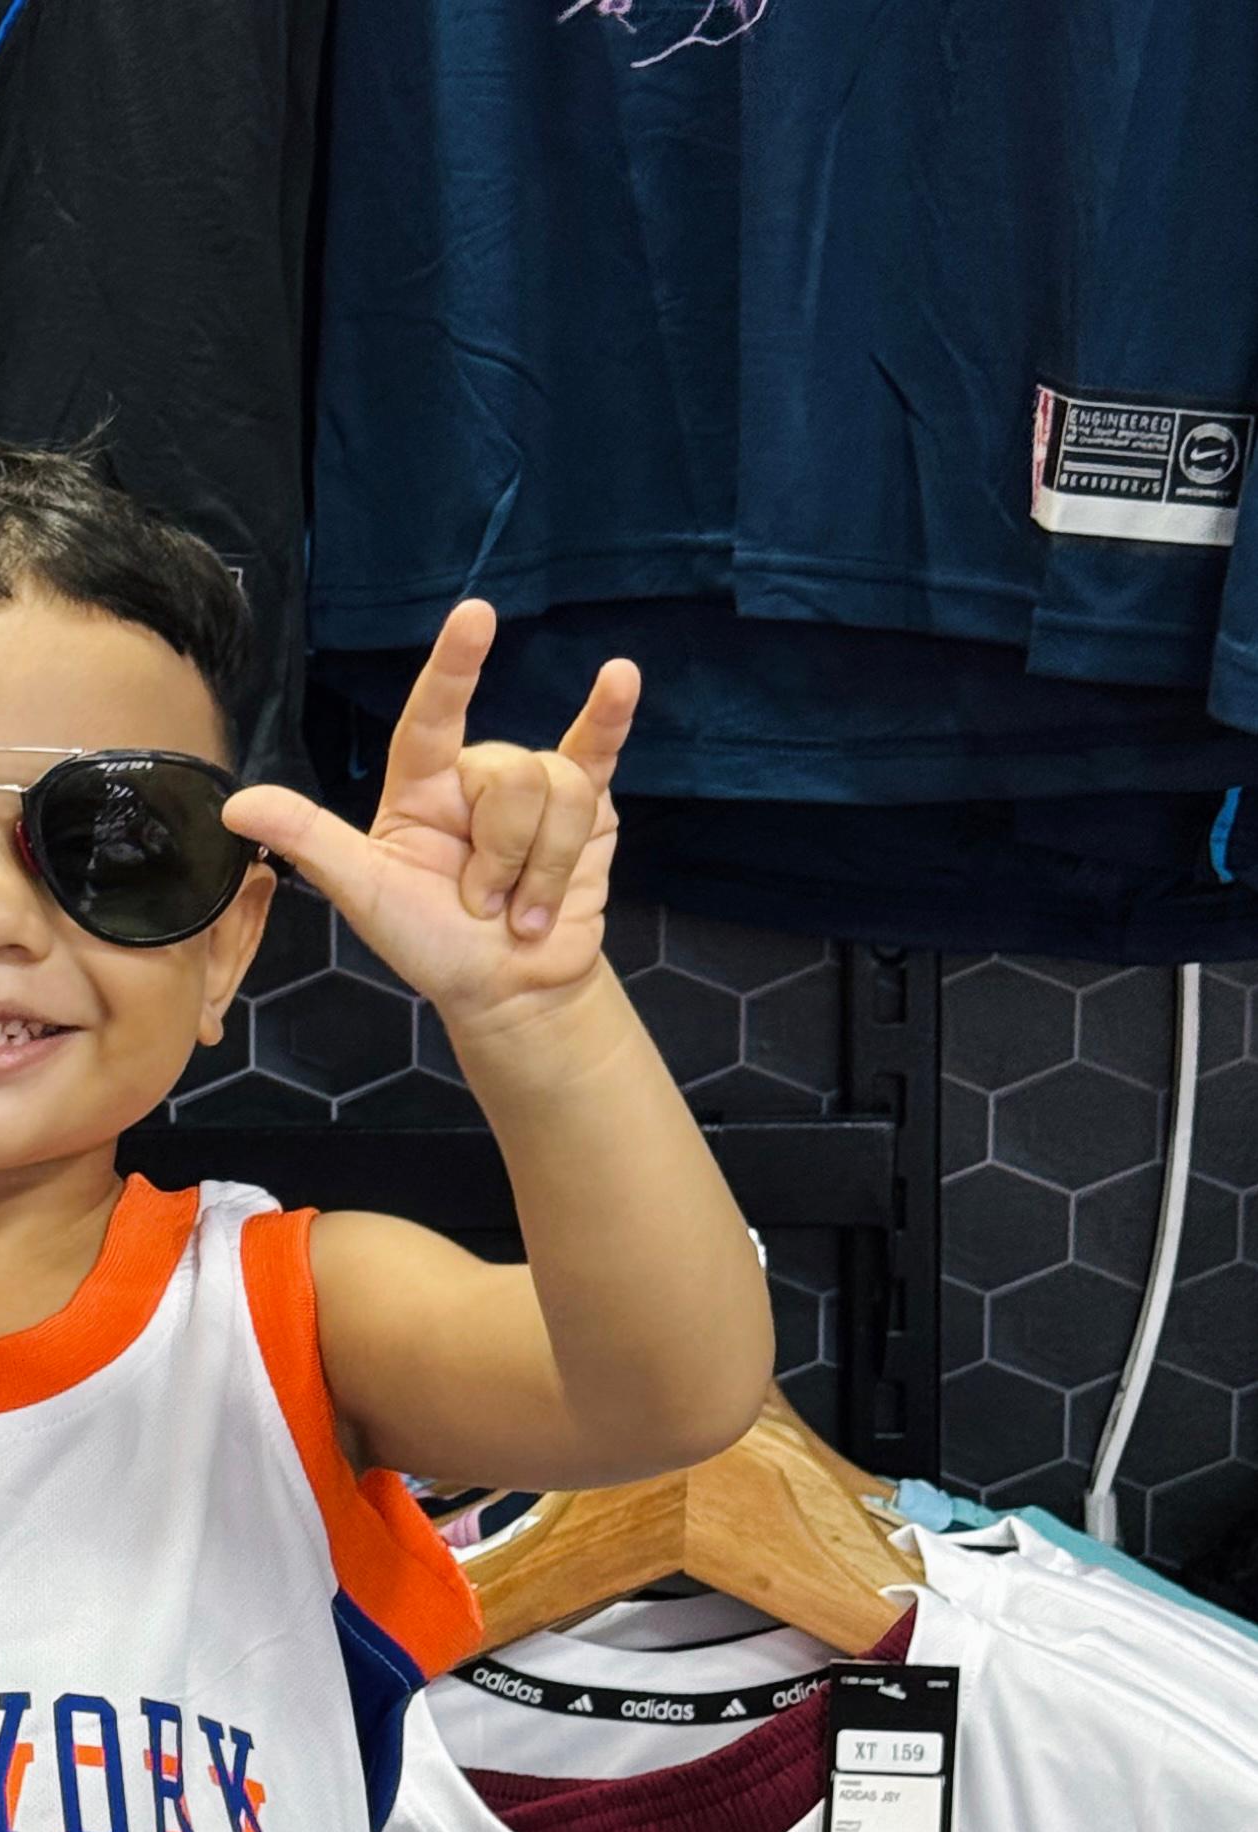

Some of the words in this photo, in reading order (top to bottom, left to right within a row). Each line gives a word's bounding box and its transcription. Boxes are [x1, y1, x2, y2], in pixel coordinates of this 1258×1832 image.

[1069, 408, 1173, 433] ENGINEERED
[473, 1667, 543, 1704] adidas
[620, 1698, 695, 1722] adidas
[855, 1742, 877, 1760] XT
[892, 1744, 924, 1762] 159
